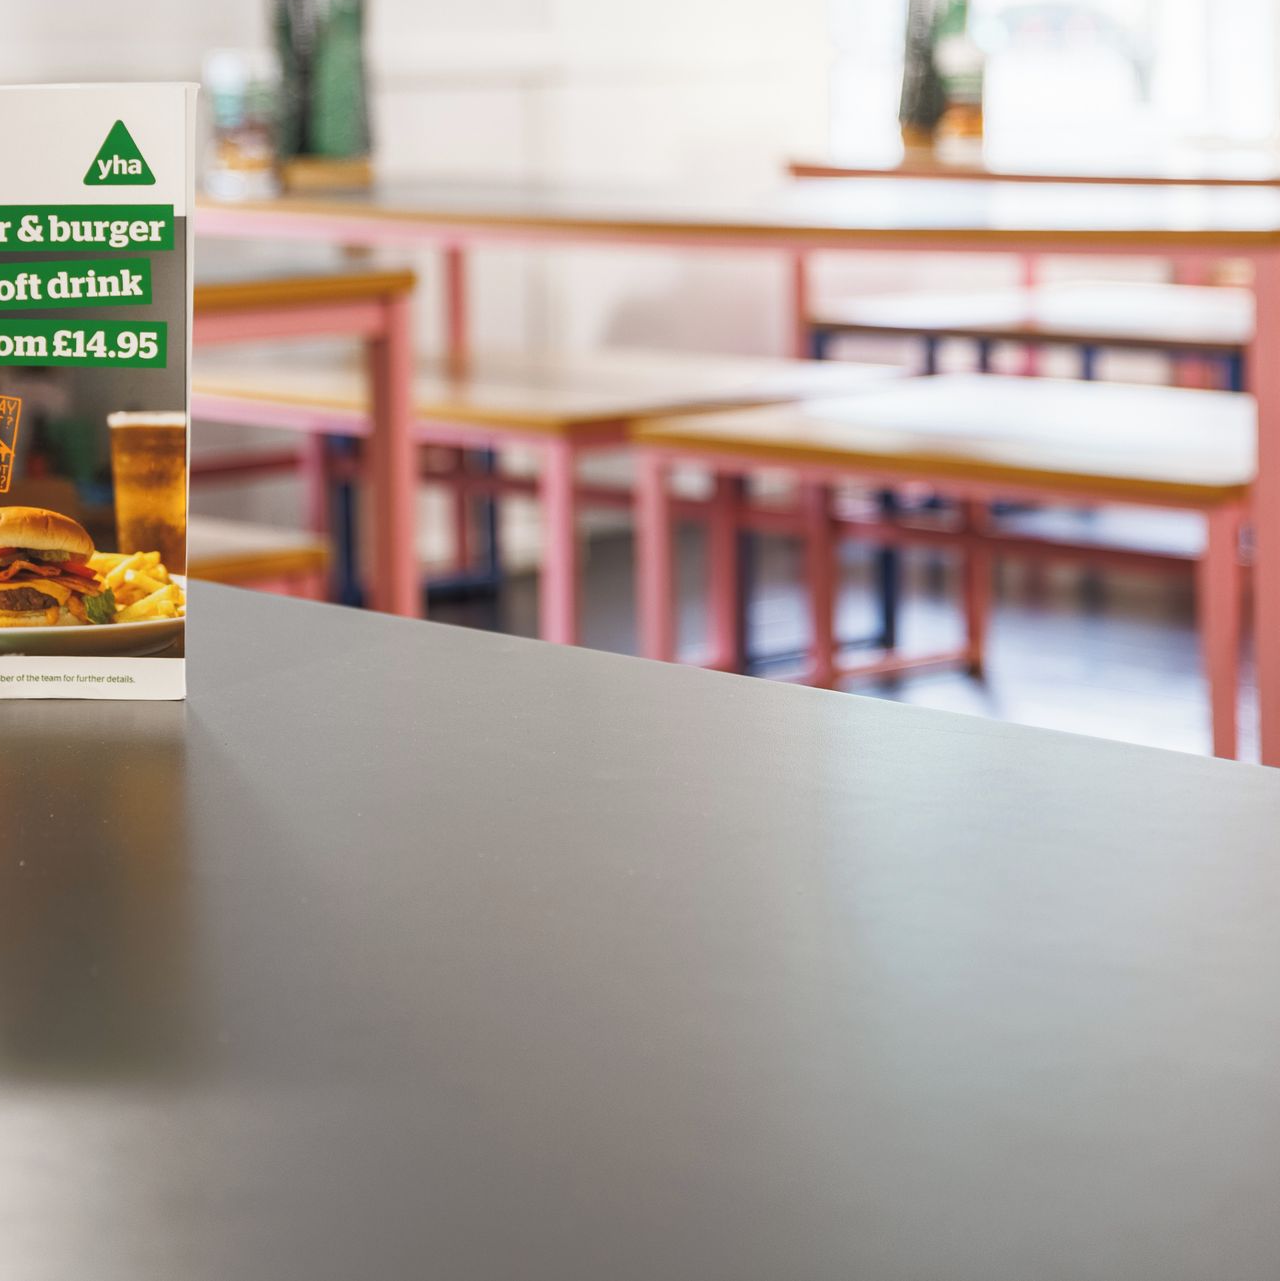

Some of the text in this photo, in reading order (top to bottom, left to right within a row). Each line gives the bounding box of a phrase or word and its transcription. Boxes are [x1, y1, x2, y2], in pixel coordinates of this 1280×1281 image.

[97, 155, 142, 180] yha
[16, 215, 44, 242] &
[48, 215, 166, 248] burger
[47, 269, 143, 299] drink
[52, 330, 158, 359] £14.95
[16, 674, 25, 683] of
[26, 674, 39, 683] the
[41, 675, 61, 683] team
[63, 674, 74, 683] for
[76, 674, 104, 684] further
[106, 675, 135, 685] details.
